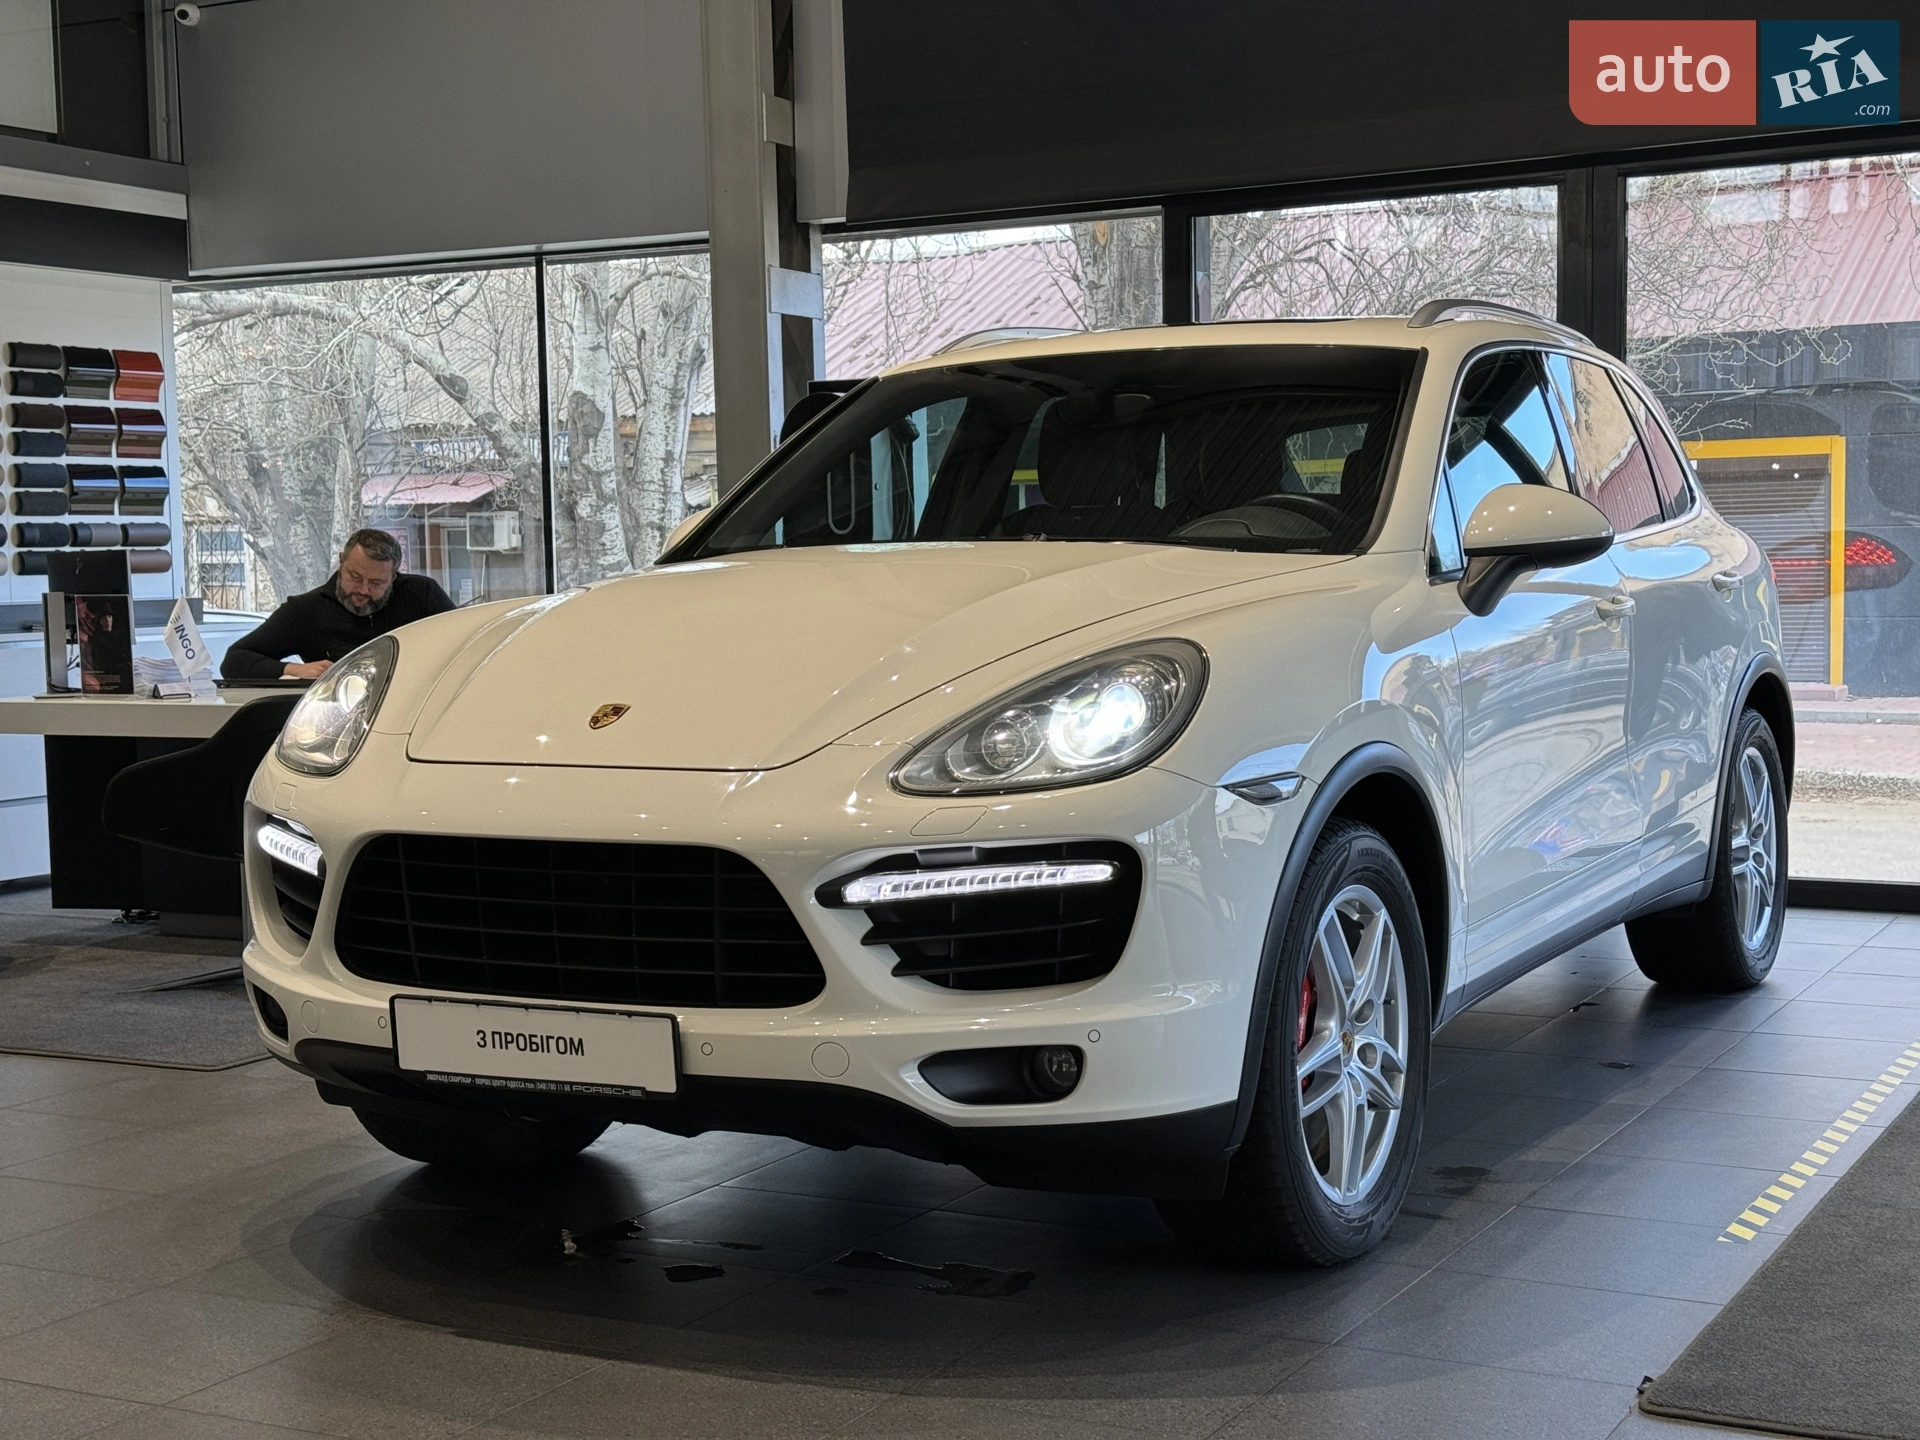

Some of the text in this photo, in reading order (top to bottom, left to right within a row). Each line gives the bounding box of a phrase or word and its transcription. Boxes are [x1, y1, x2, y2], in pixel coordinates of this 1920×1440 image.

[173, 623, 196, 660] INGO
[490, 1030, 585, 1056] ПРОБІГОМ
[572, 1085, 643, 1097] PORSCHE
